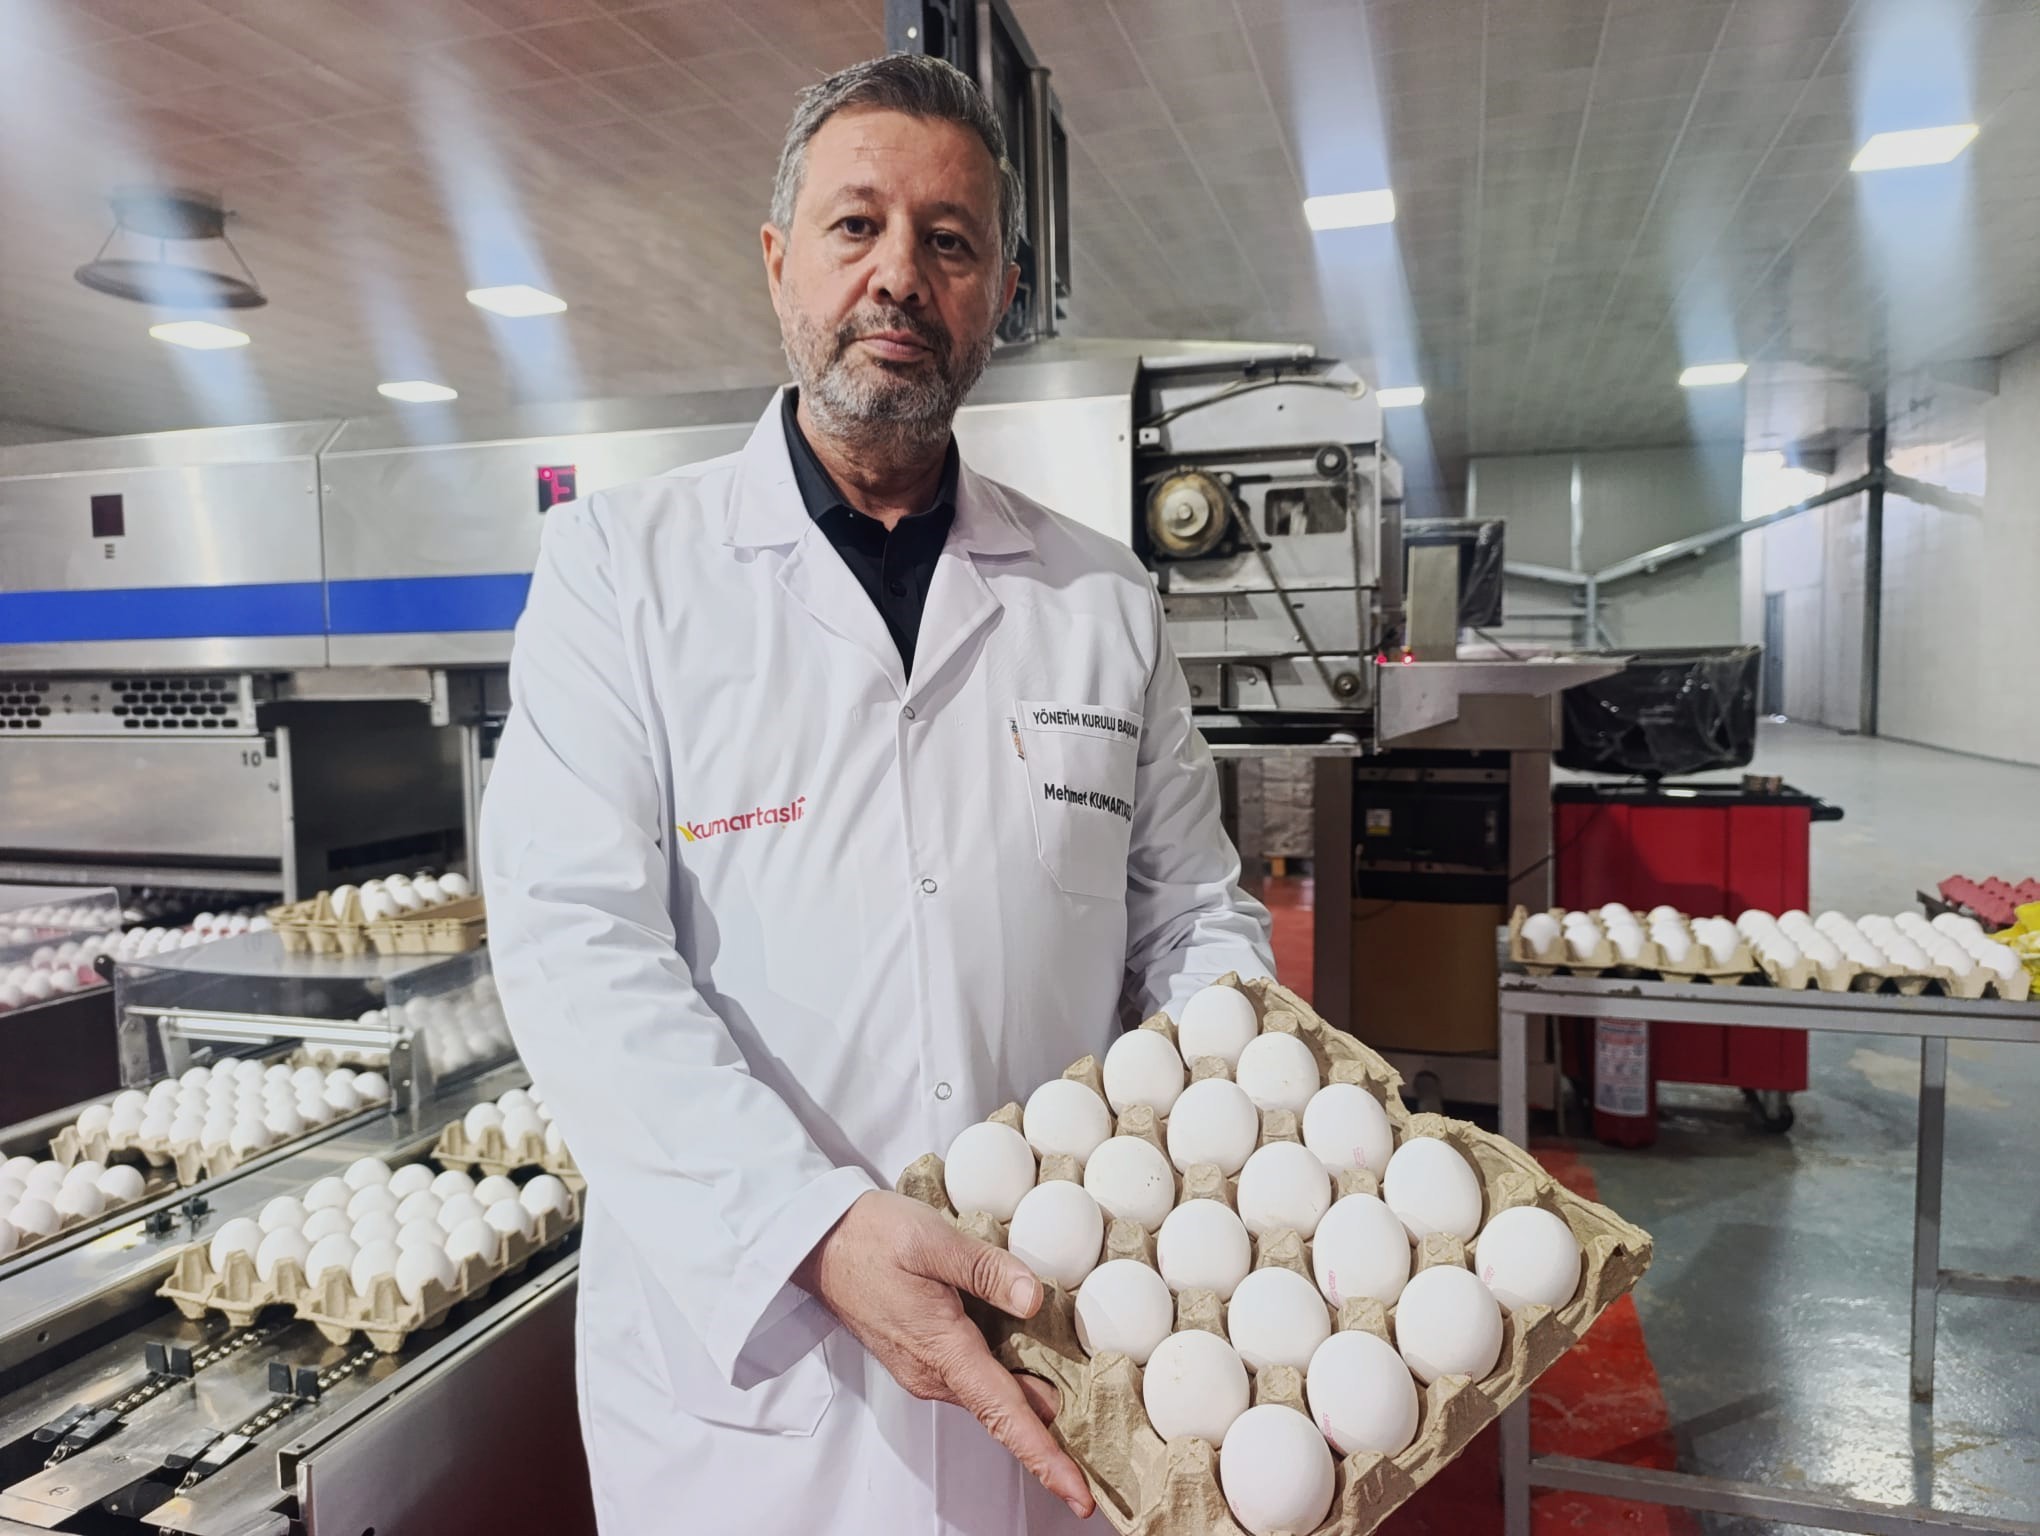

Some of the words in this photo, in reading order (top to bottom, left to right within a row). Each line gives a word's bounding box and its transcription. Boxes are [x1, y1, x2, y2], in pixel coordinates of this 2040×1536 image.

[1033, 708, 1080, 726] YÖNETİM
[1081, 713, 1116, 731] KURULU
[242, 750, 262, 767] 10
[1044, 782, 1088, 806] Mehmet
